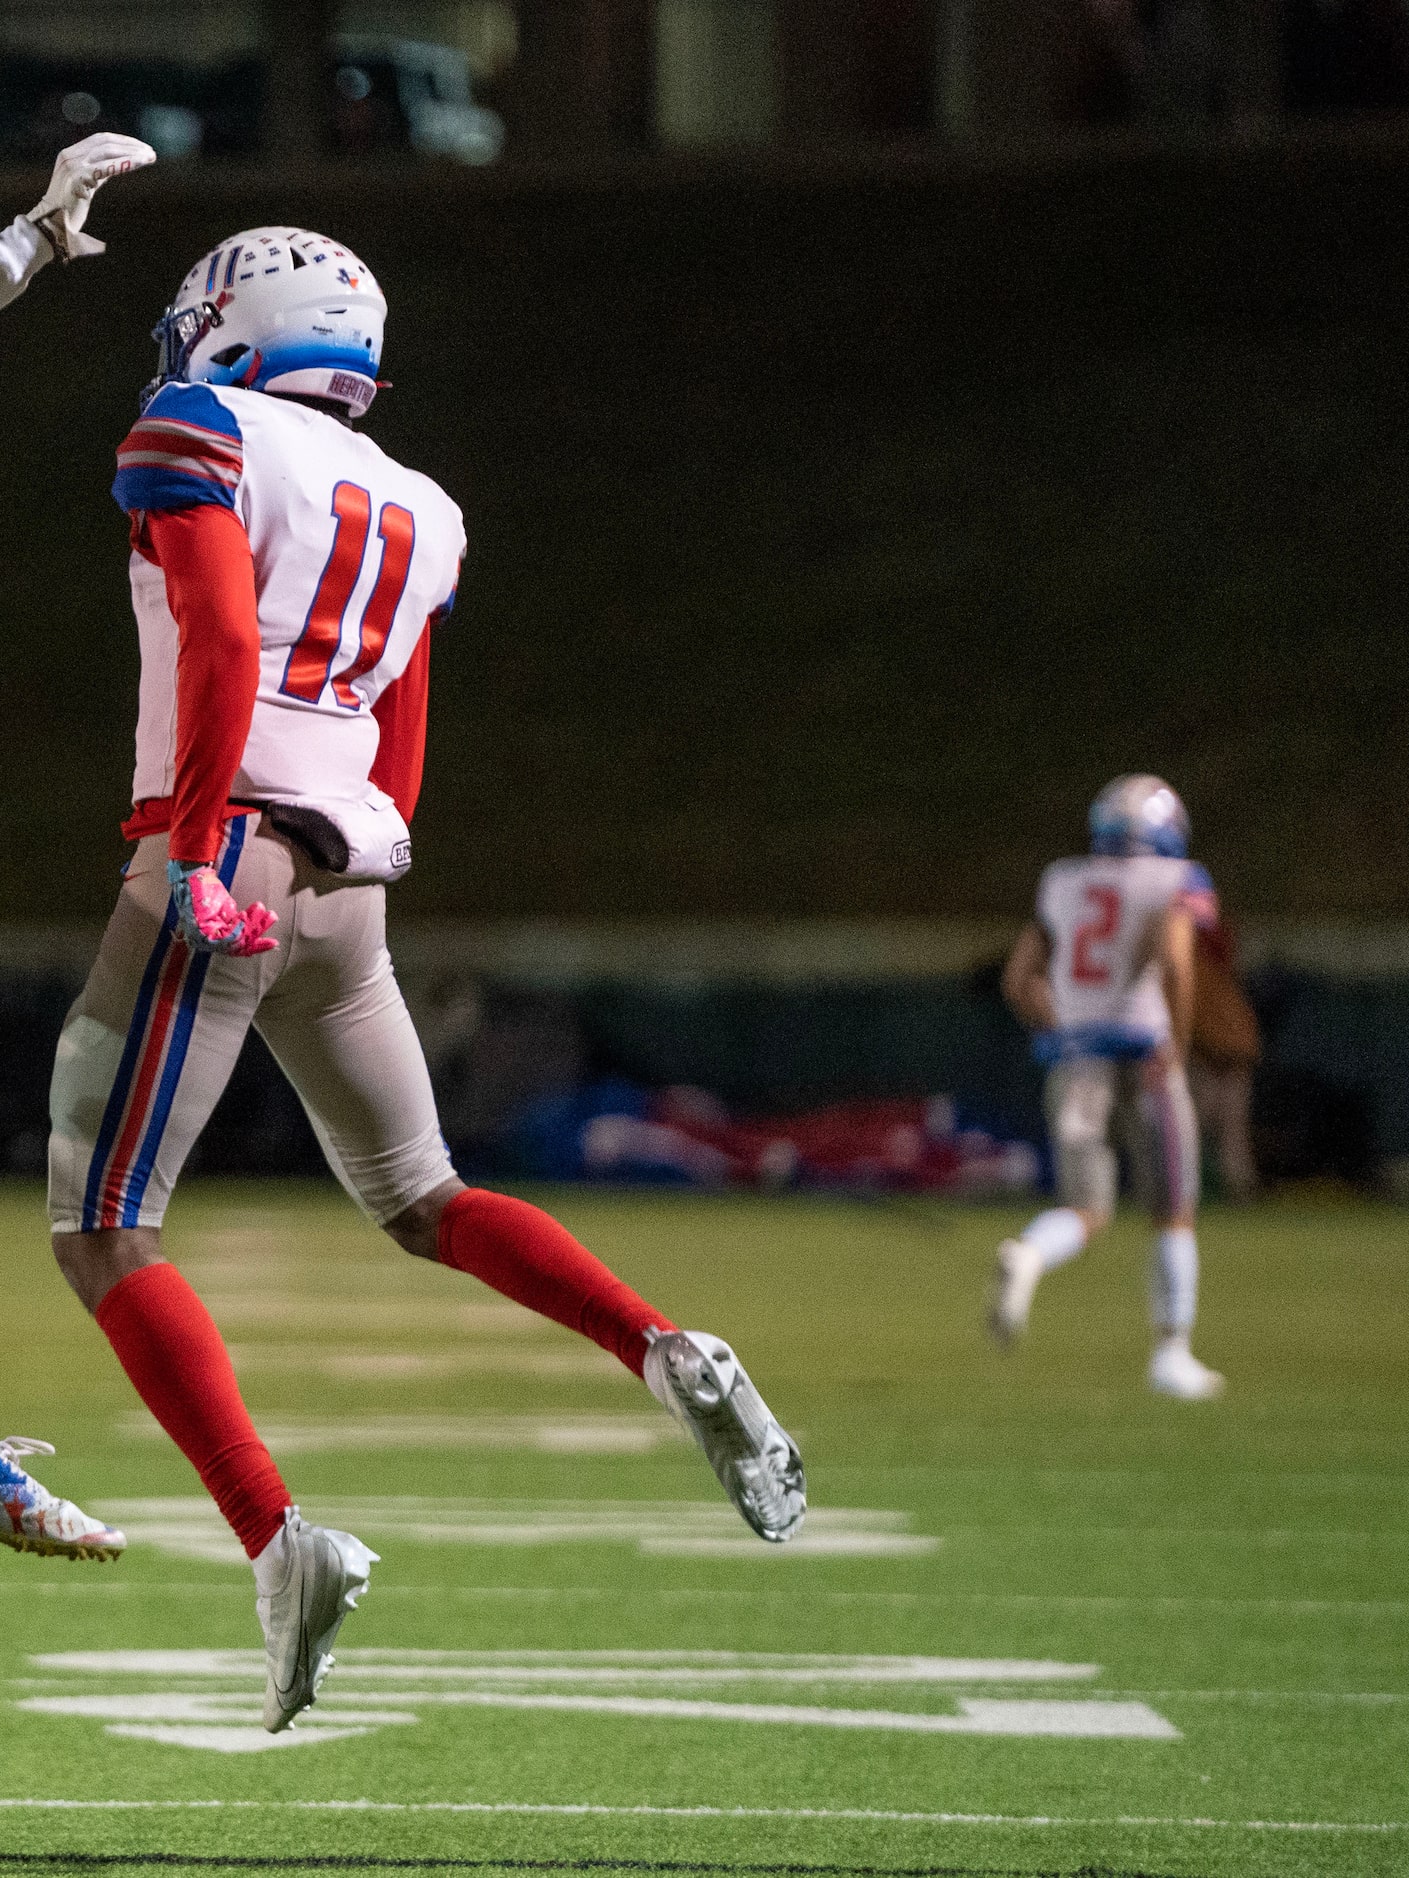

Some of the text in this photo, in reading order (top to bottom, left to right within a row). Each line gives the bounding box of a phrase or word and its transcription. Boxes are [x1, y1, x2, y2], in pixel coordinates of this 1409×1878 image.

[205, 245, 244, 296] 11
[279, 479, 415, 711] 11
[1071, 884, 1122, 985] 2
